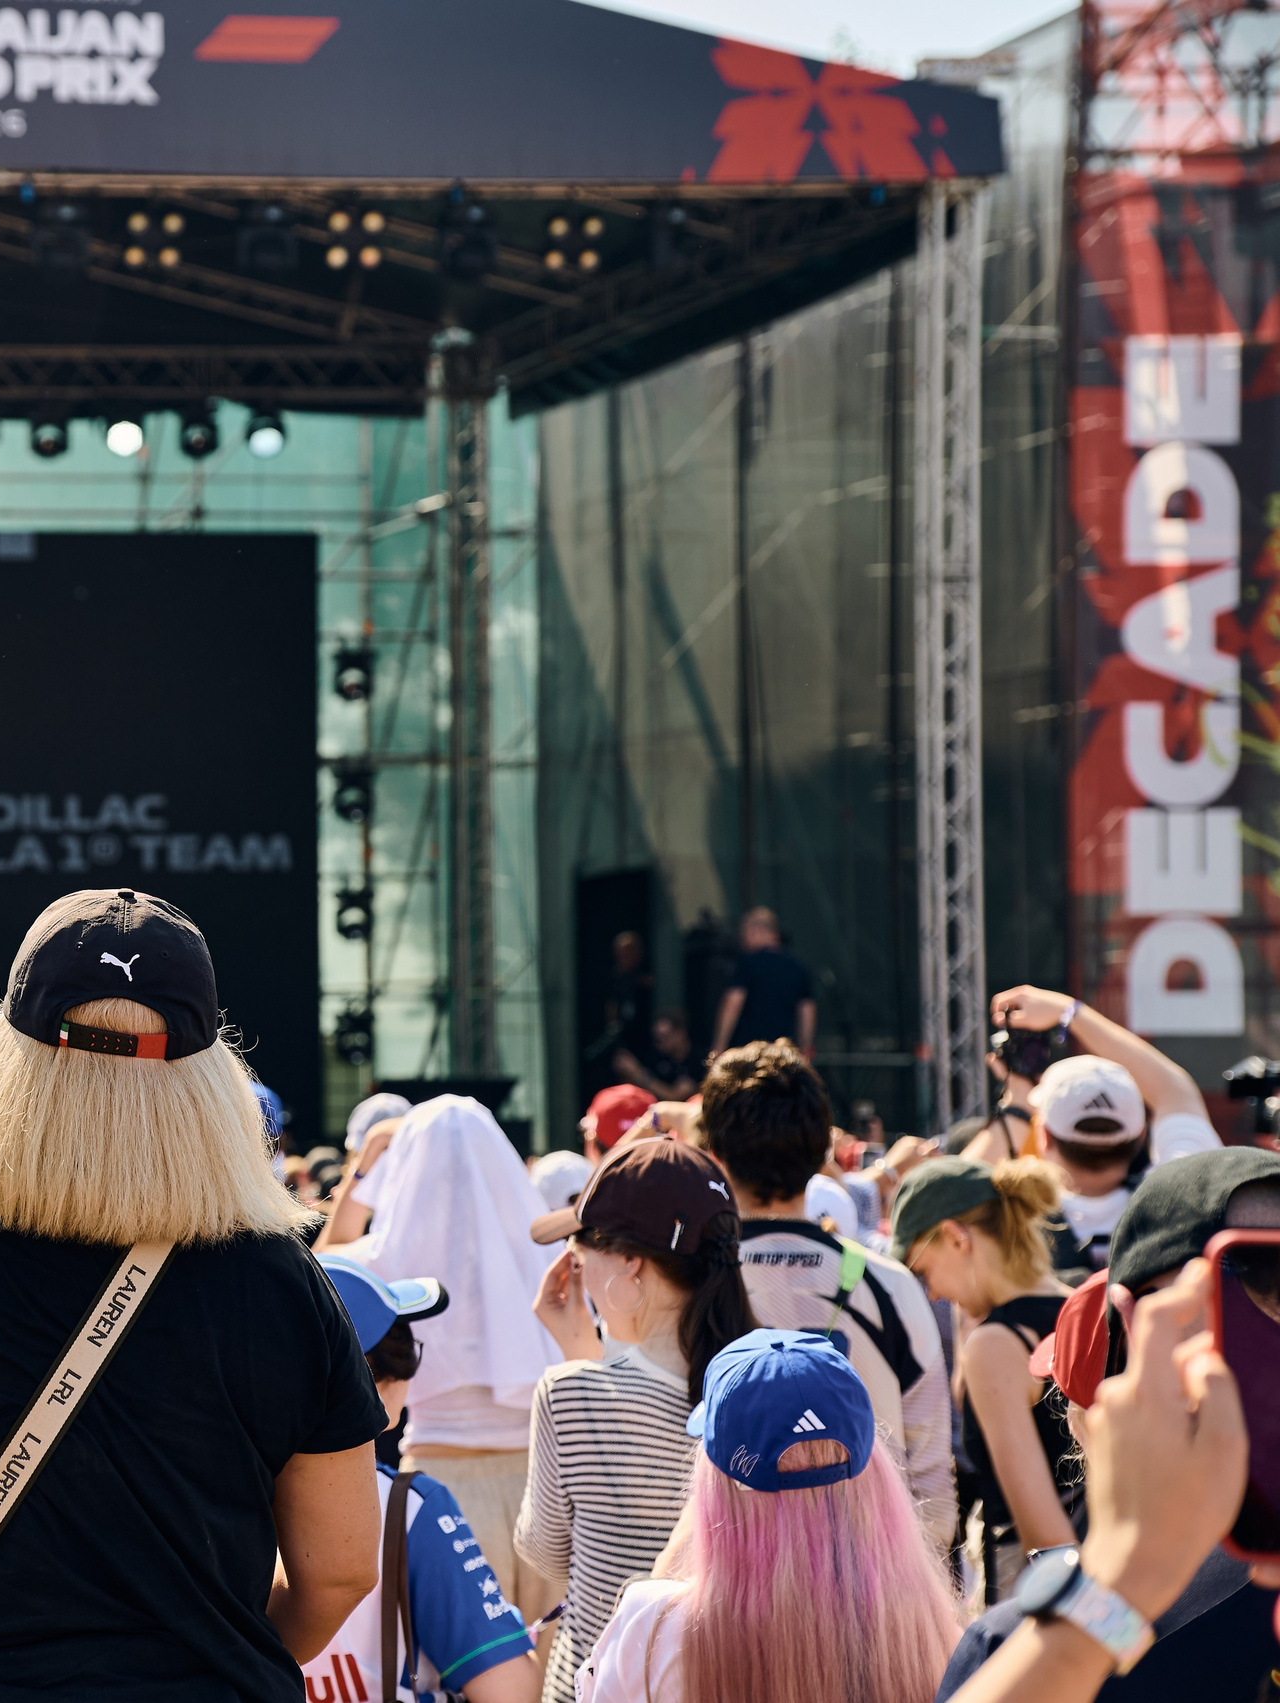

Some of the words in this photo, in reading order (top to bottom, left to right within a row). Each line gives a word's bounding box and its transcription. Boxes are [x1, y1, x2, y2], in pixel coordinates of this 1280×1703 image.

[17, 54, 158, 104] PRIX
[1123, 333, 1244, 1036] DECADE
[133, 835, 292, 872] TEAM
[86, 1264, 146, 1347] LAUREN
[47, 1369, 82, 1405] LRL
[305, 1653, 369, 1703] ull
